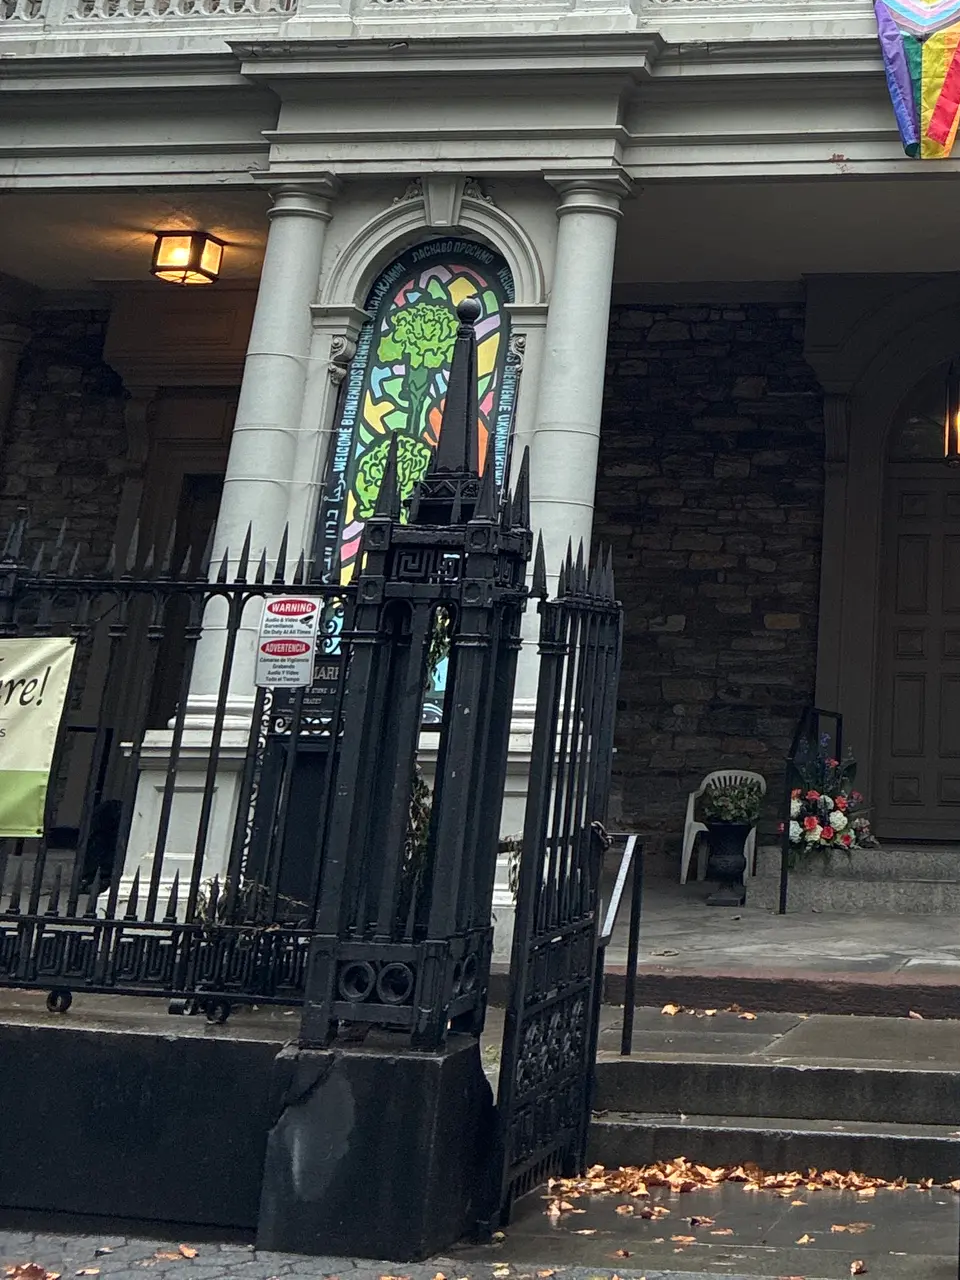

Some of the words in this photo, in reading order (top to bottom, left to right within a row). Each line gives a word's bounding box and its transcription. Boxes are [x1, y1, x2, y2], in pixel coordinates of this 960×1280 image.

[352, 324, 374, 368] BIENVENUE
[341, 368, 364, 426] BIENVENIDOS
[333, 428, 352, 472] WELCOME
[272, 603, 312, 612] WARNING
[265, 644, 306, 652] ADVERTENCIA
[0, 666, 51, 706] re!
